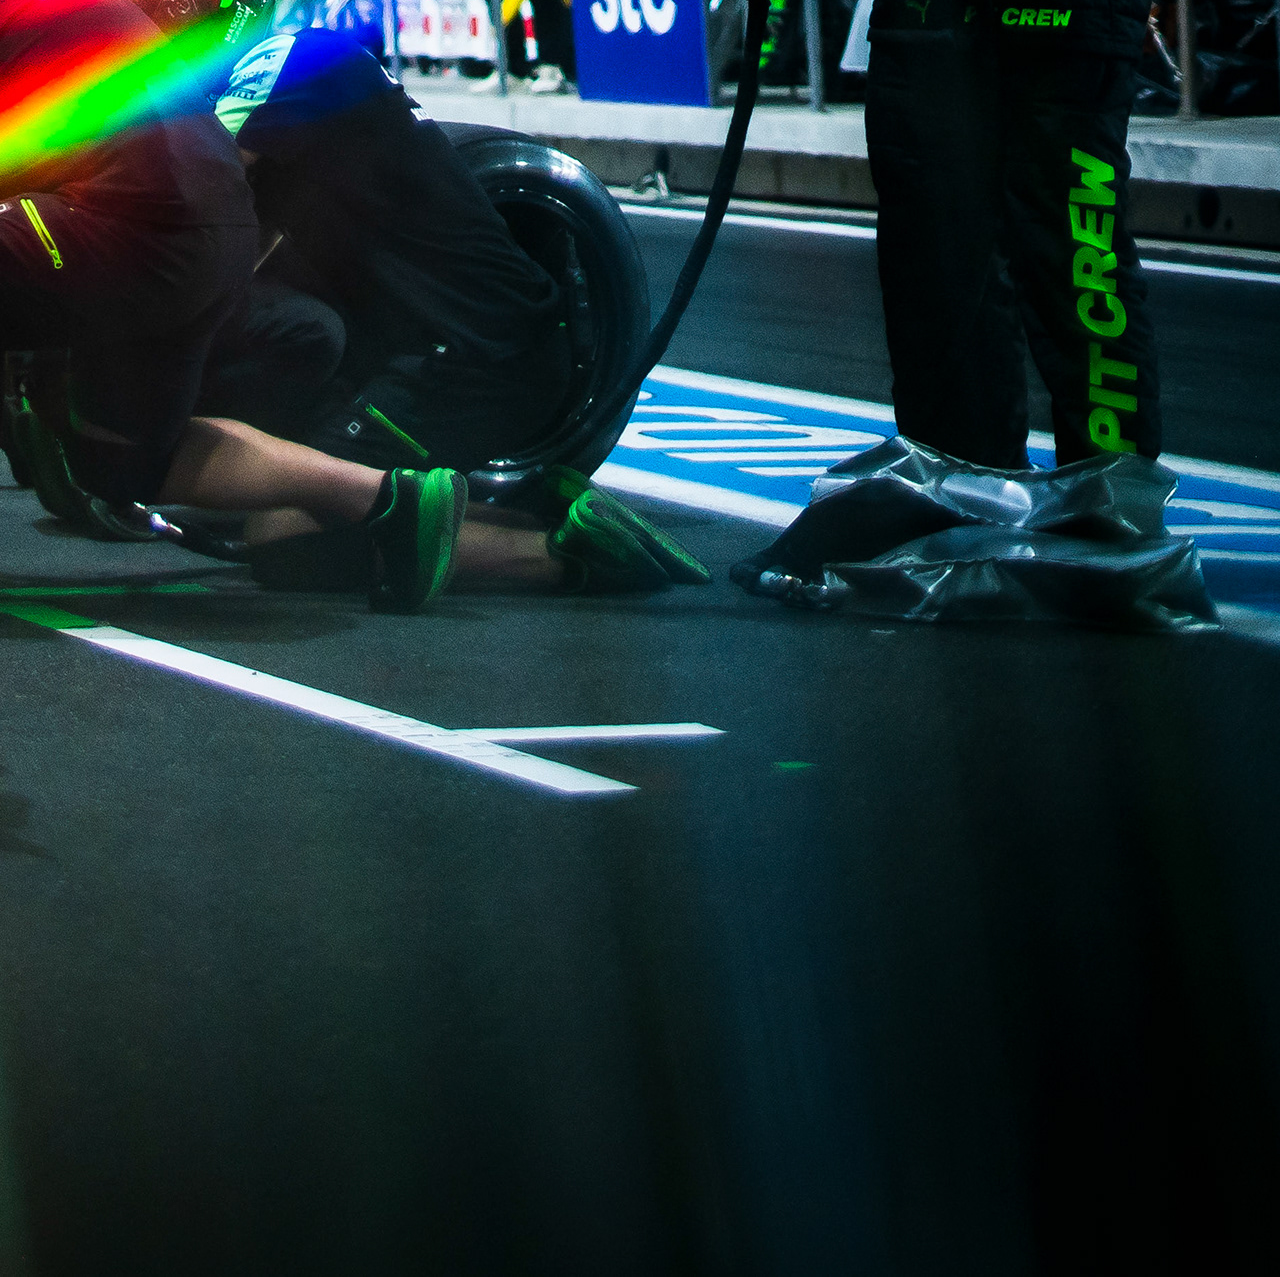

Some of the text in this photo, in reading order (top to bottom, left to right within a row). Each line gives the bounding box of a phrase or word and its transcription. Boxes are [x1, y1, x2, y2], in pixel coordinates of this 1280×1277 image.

[224, 3, 248, 43] MASCOT
[1000, 7, 1073, 28] CREW
[1068, 146, 1138, 454] PIT CREW
